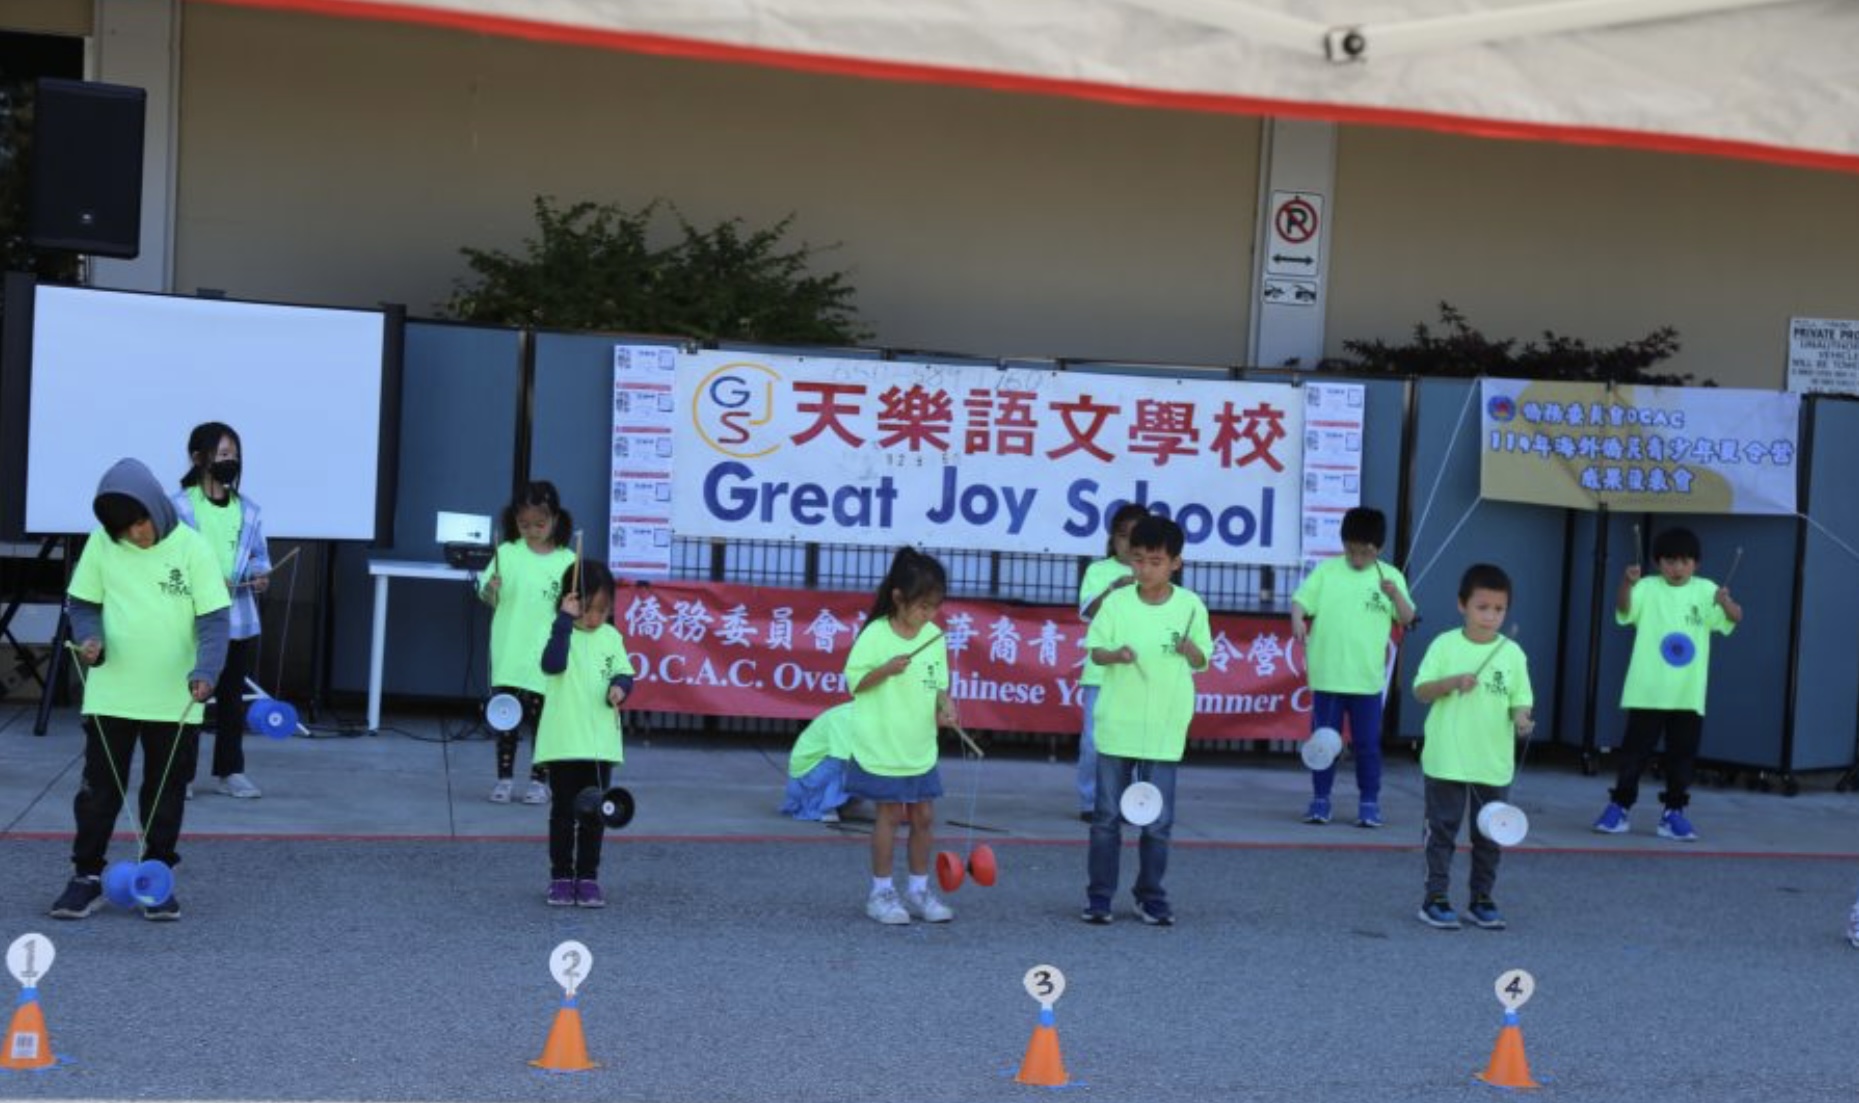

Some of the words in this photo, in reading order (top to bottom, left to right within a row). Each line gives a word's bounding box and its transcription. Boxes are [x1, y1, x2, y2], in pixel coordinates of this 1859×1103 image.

[1794, 327, 1834, 340] PRIVATE
[789, 381, 1287, 473] 天樂語文學校
[703, 461, 898, 528] Great
[926, 465, 1038, 535] Joy
[950, 671, 1046, 704] hinese
[1195, 691, 1284, 714] mmer
[20, 939, 39, 978] 1
[562, 949, 582, 977] 2
[1033, 970, 1054, 996] 3
[1504, 976, 1523, 1000] 4
